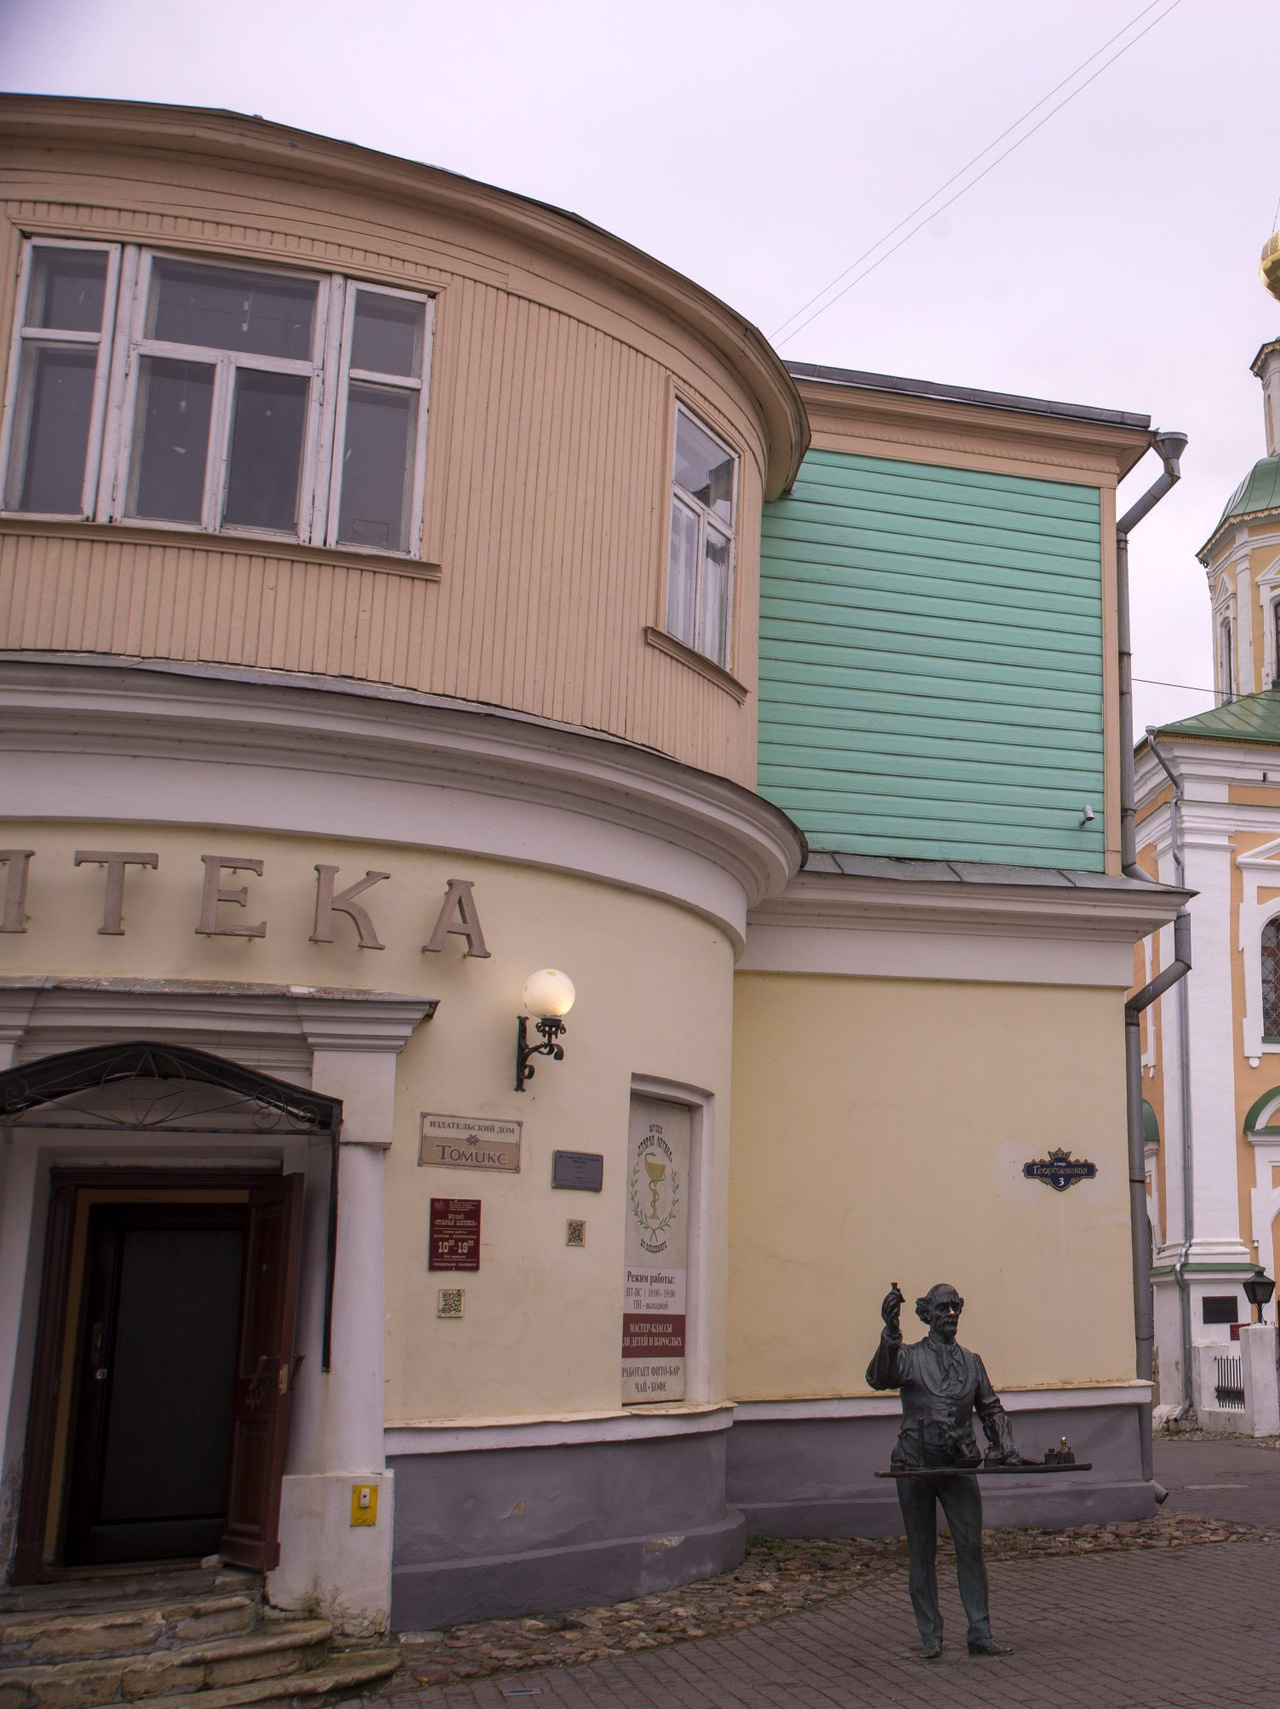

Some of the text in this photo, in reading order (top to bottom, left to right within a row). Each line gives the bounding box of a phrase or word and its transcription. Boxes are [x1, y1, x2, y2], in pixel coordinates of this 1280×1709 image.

[430, 1120, 515, 1134] ИЗДАТЕЛЬСКИЙ ДОМ
[1033, 1165, 1088, 1175] Георгиевская
[1058, 1177, 1065, 1187] 3
[627, 1270, 675, 1286] Режим работы:
[626, 1287, 643, 1297] ВТ-ВС
[633, 1299, 642, 1310] ПН
[631, 1335, 649, 1347] ДЕТЕЙ
[649, 1336, 653, 1346] И
[654, 1336, 682, 1346] ВЗРОСЛЫХ
[622, 1366, 680, 1378] РАБОТАЕТ ФИТО-БАР
[635, 1381, 648, 1393] ЧАЙ
